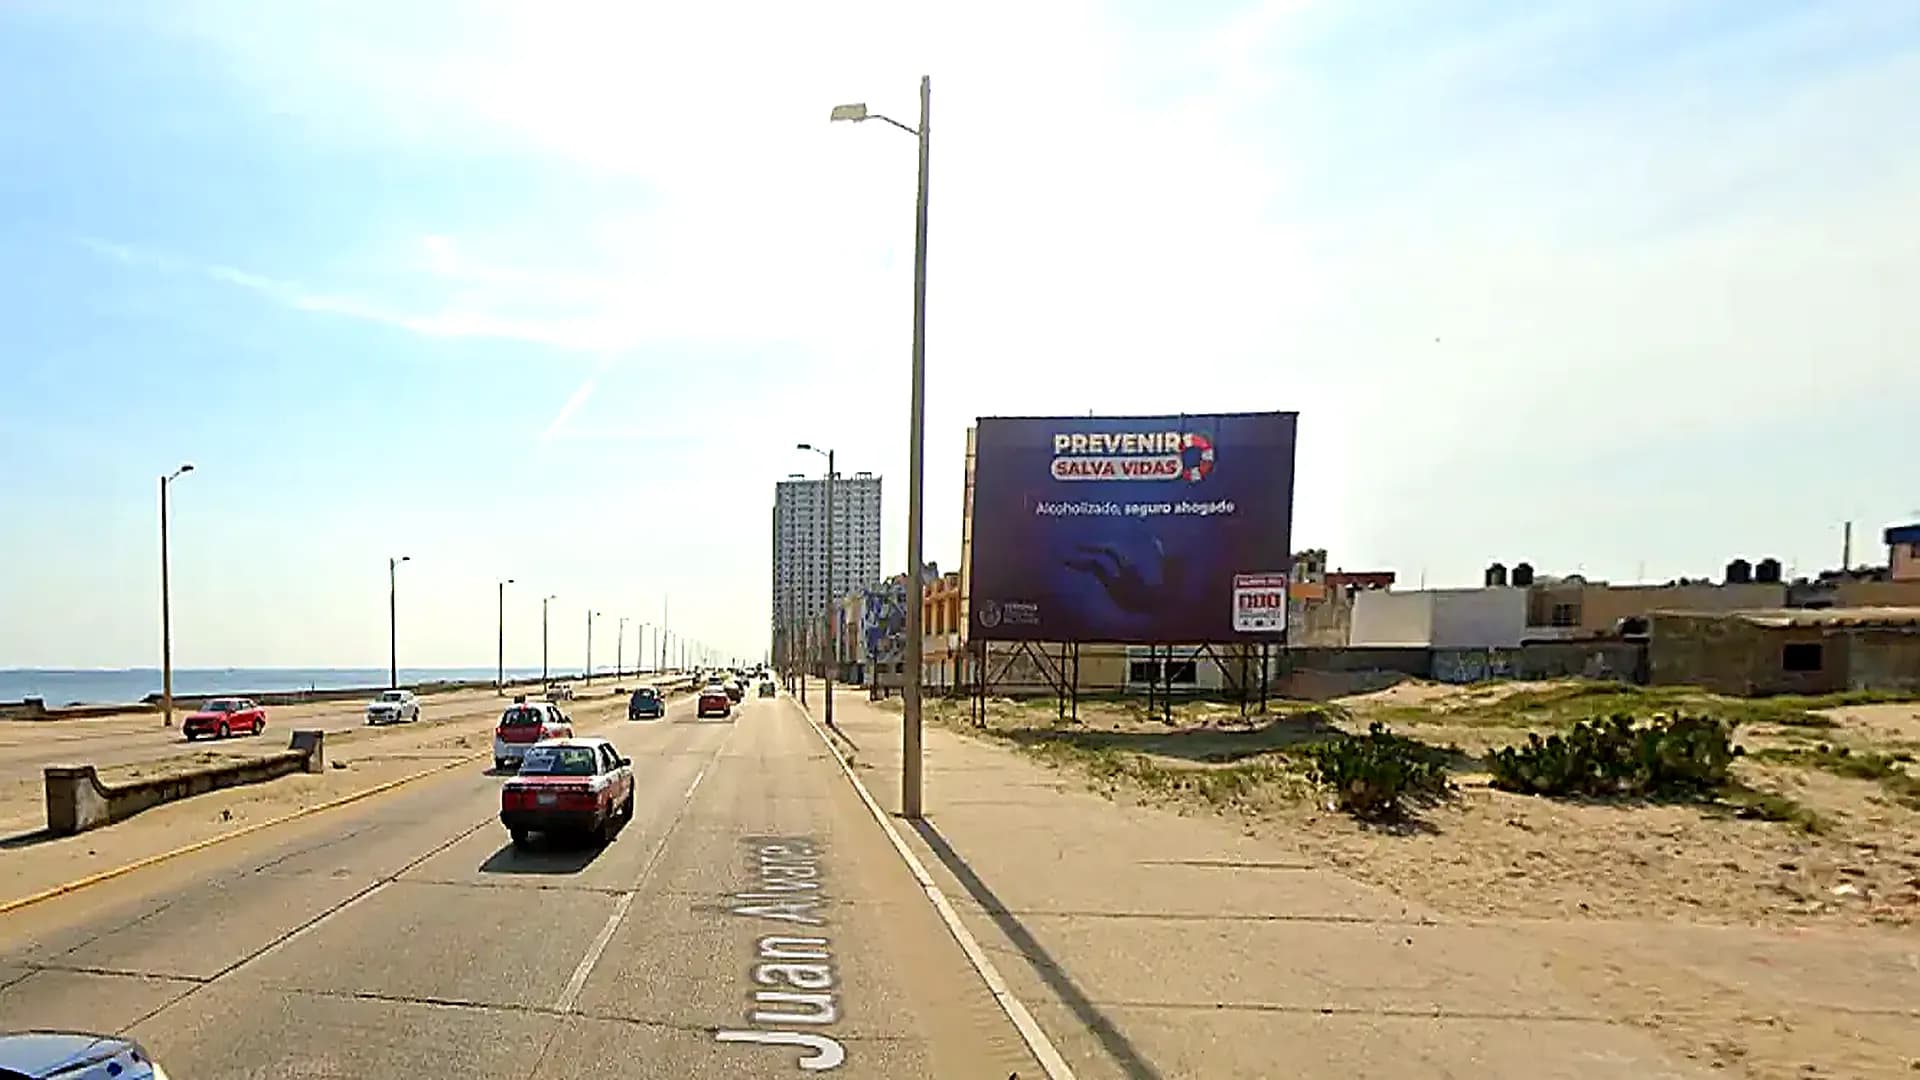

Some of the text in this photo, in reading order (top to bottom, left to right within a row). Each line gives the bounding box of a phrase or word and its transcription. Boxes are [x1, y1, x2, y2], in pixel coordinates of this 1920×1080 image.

[1054, 432, 1182, 454] PREVENIR
[1055, 459, 1177, 476] SALVA VIDAS
[1036, 500, 1235, 517] Alcoholizado, seguro ahogado
